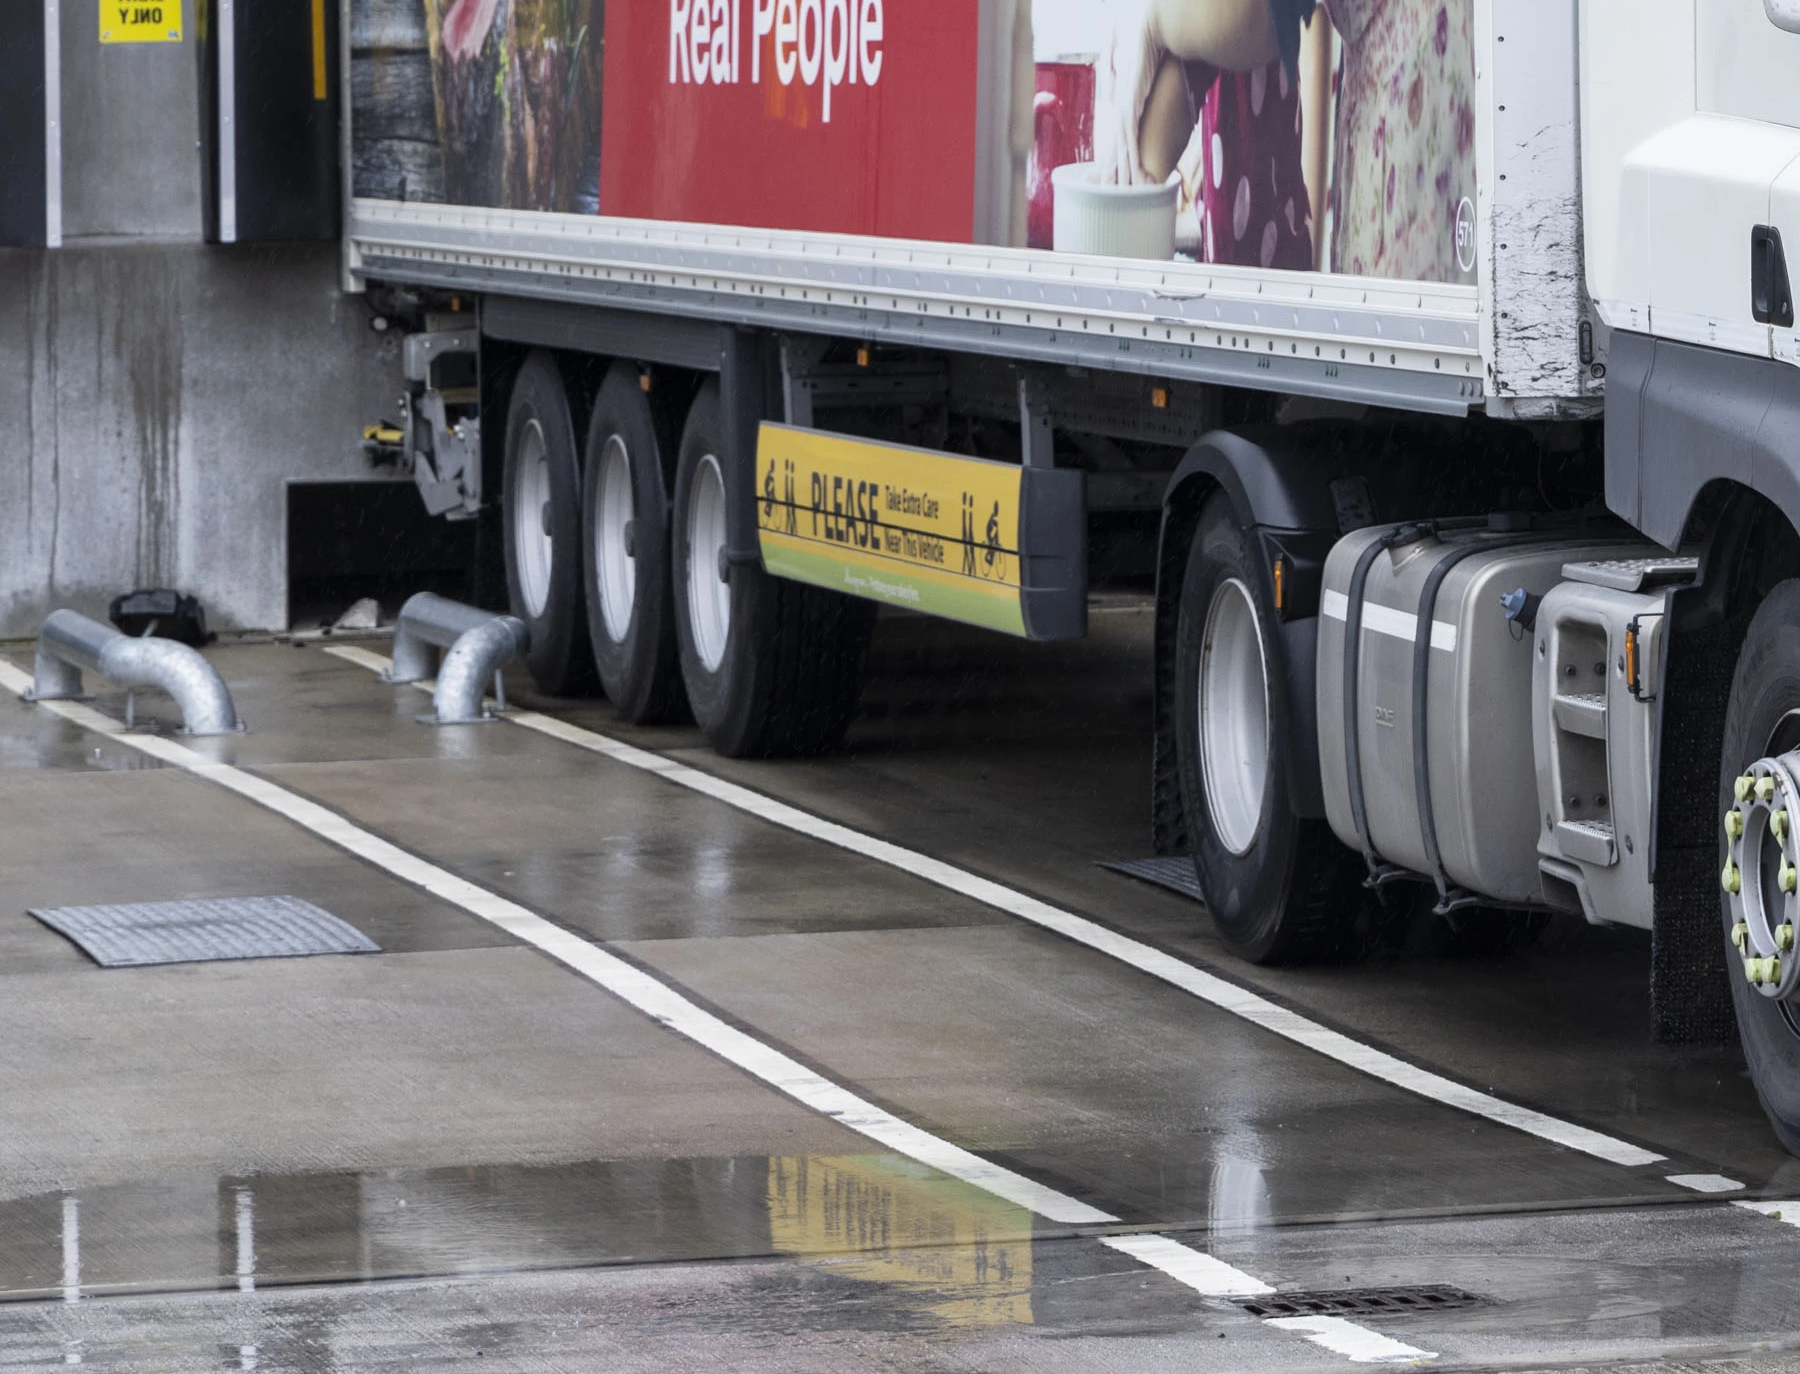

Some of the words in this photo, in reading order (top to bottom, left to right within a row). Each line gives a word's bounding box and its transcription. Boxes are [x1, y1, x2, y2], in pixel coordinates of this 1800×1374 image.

[811, 470, 881, 551] PLEASE
[885, 484, 901, 512] Take
[902, 488, 921, 517] Extra
[922, 492, 940, 520] Care
[885, 527, 902, 554] Near
[902, 528, 918, 559] This
[918, 534, 945, 564] Vehicle
